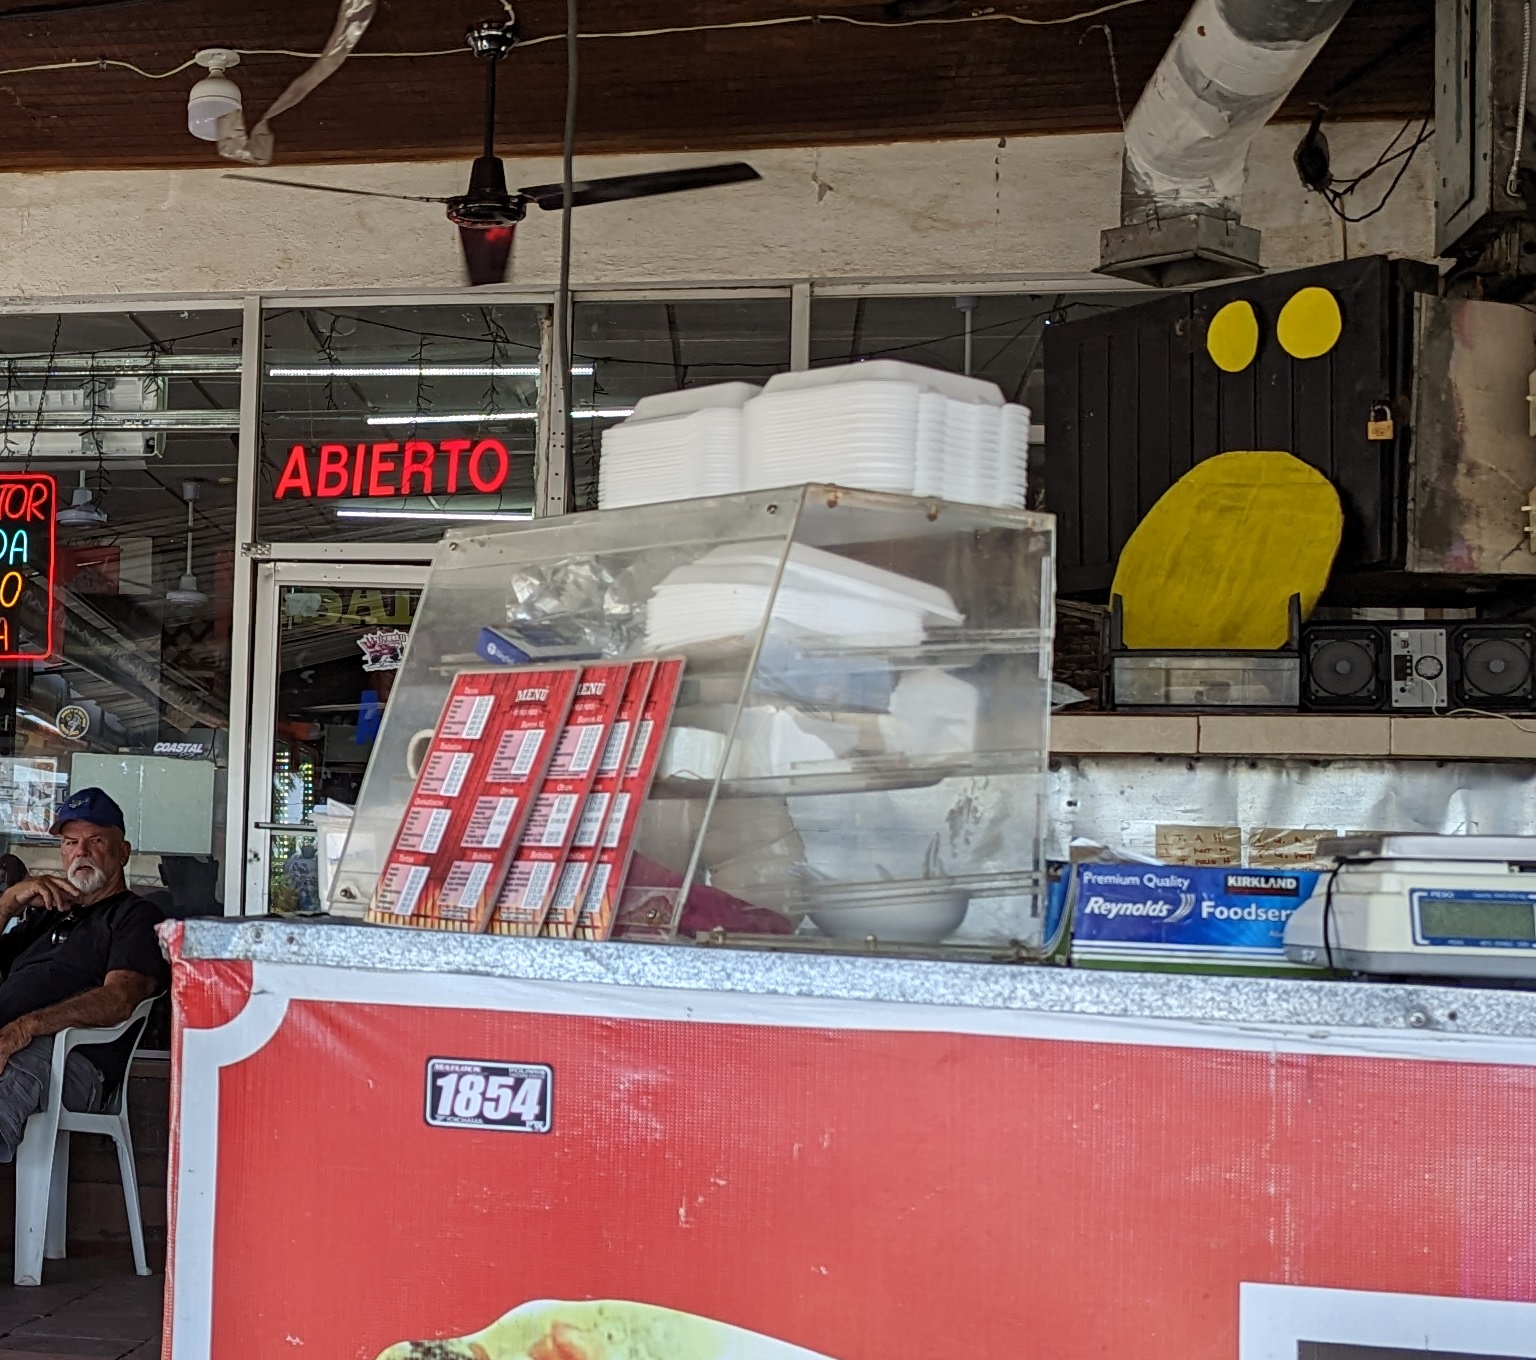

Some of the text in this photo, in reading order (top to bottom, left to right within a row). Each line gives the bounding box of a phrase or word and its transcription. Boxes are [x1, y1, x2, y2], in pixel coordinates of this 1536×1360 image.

[274, 438, 509, 499] ABIERTO
[153, 742, 204, 753] COASTAL
[1082, 871, 1191, 891] Premium Quality
[1227, 875, 1298, 890] KIRKLAND
[1084, 895, 1172, 919] Reynolds
[1201, 900, 1291, 922] Foodser
[435, 1072, 543, 1121] 1854
